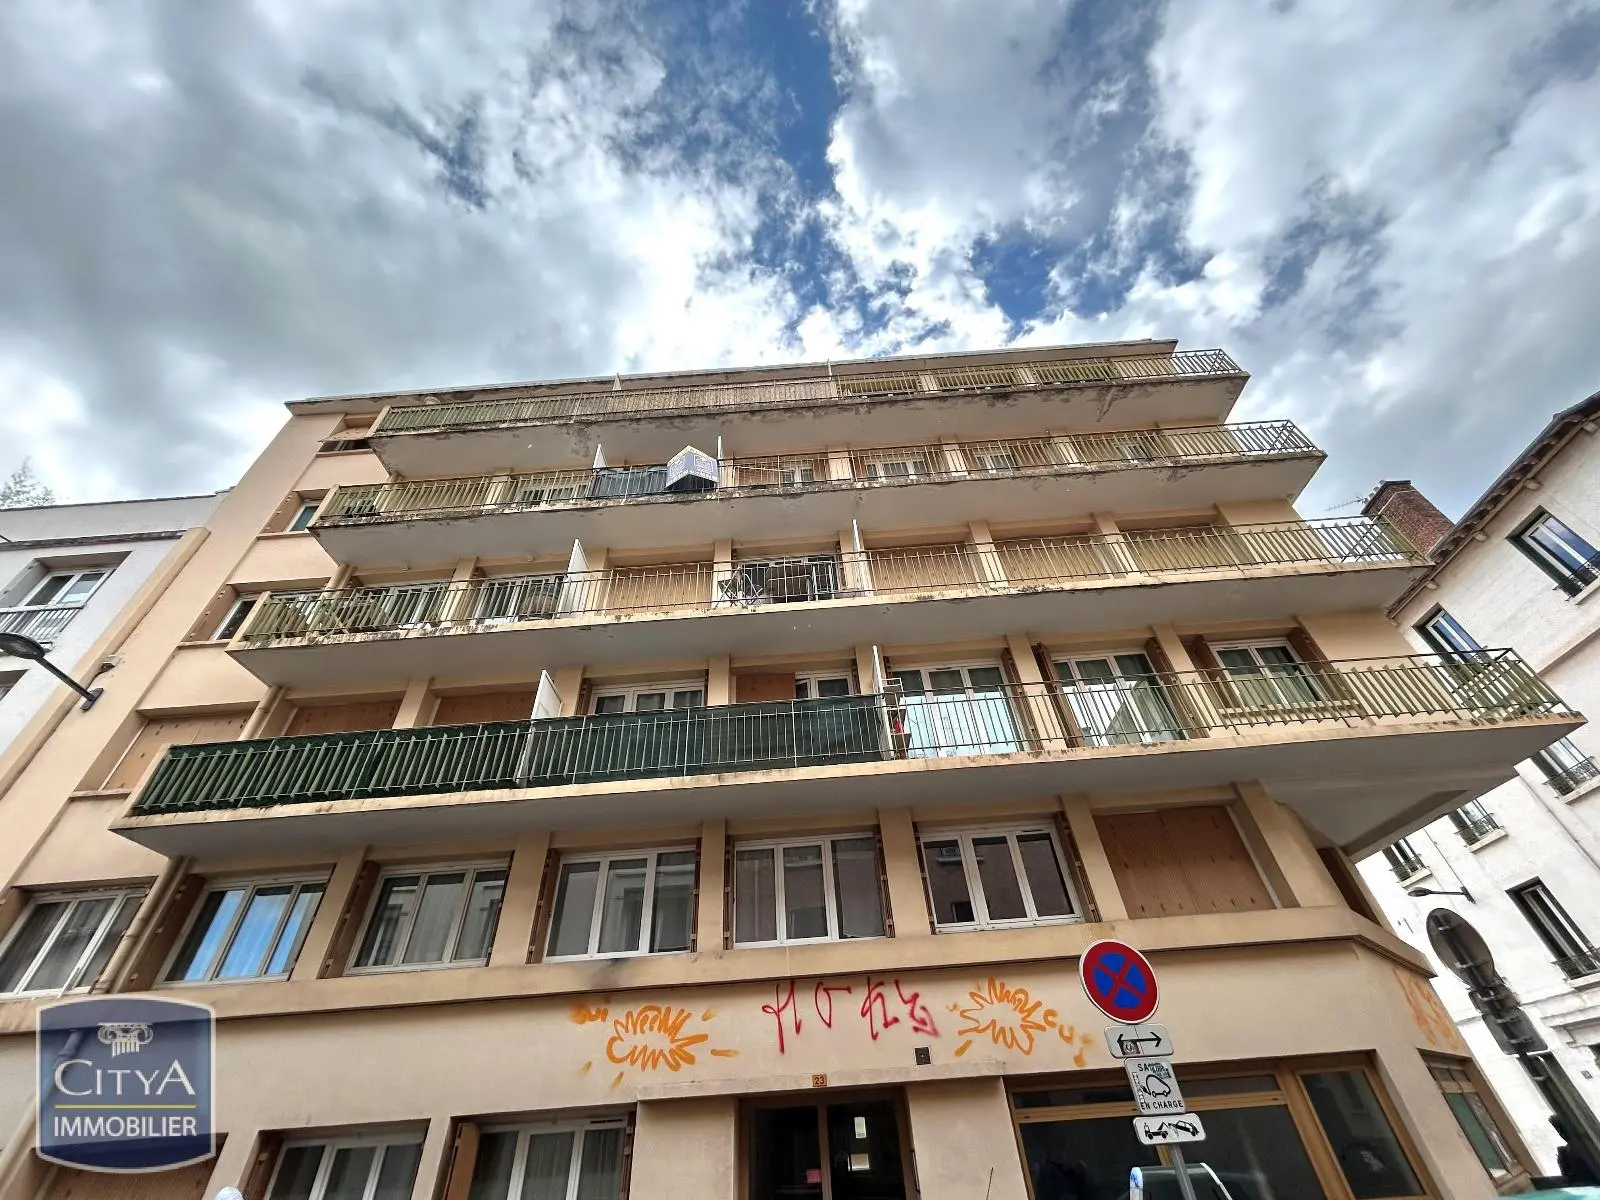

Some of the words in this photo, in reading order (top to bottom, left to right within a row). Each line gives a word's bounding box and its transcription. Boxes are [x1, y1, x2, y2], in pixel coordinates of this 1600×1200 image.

[815, 1076, 825, 1085] 23
[1140, 1102, 1151, 1110] EN
[1152, 1100, 1184, 1109] CHARGE
